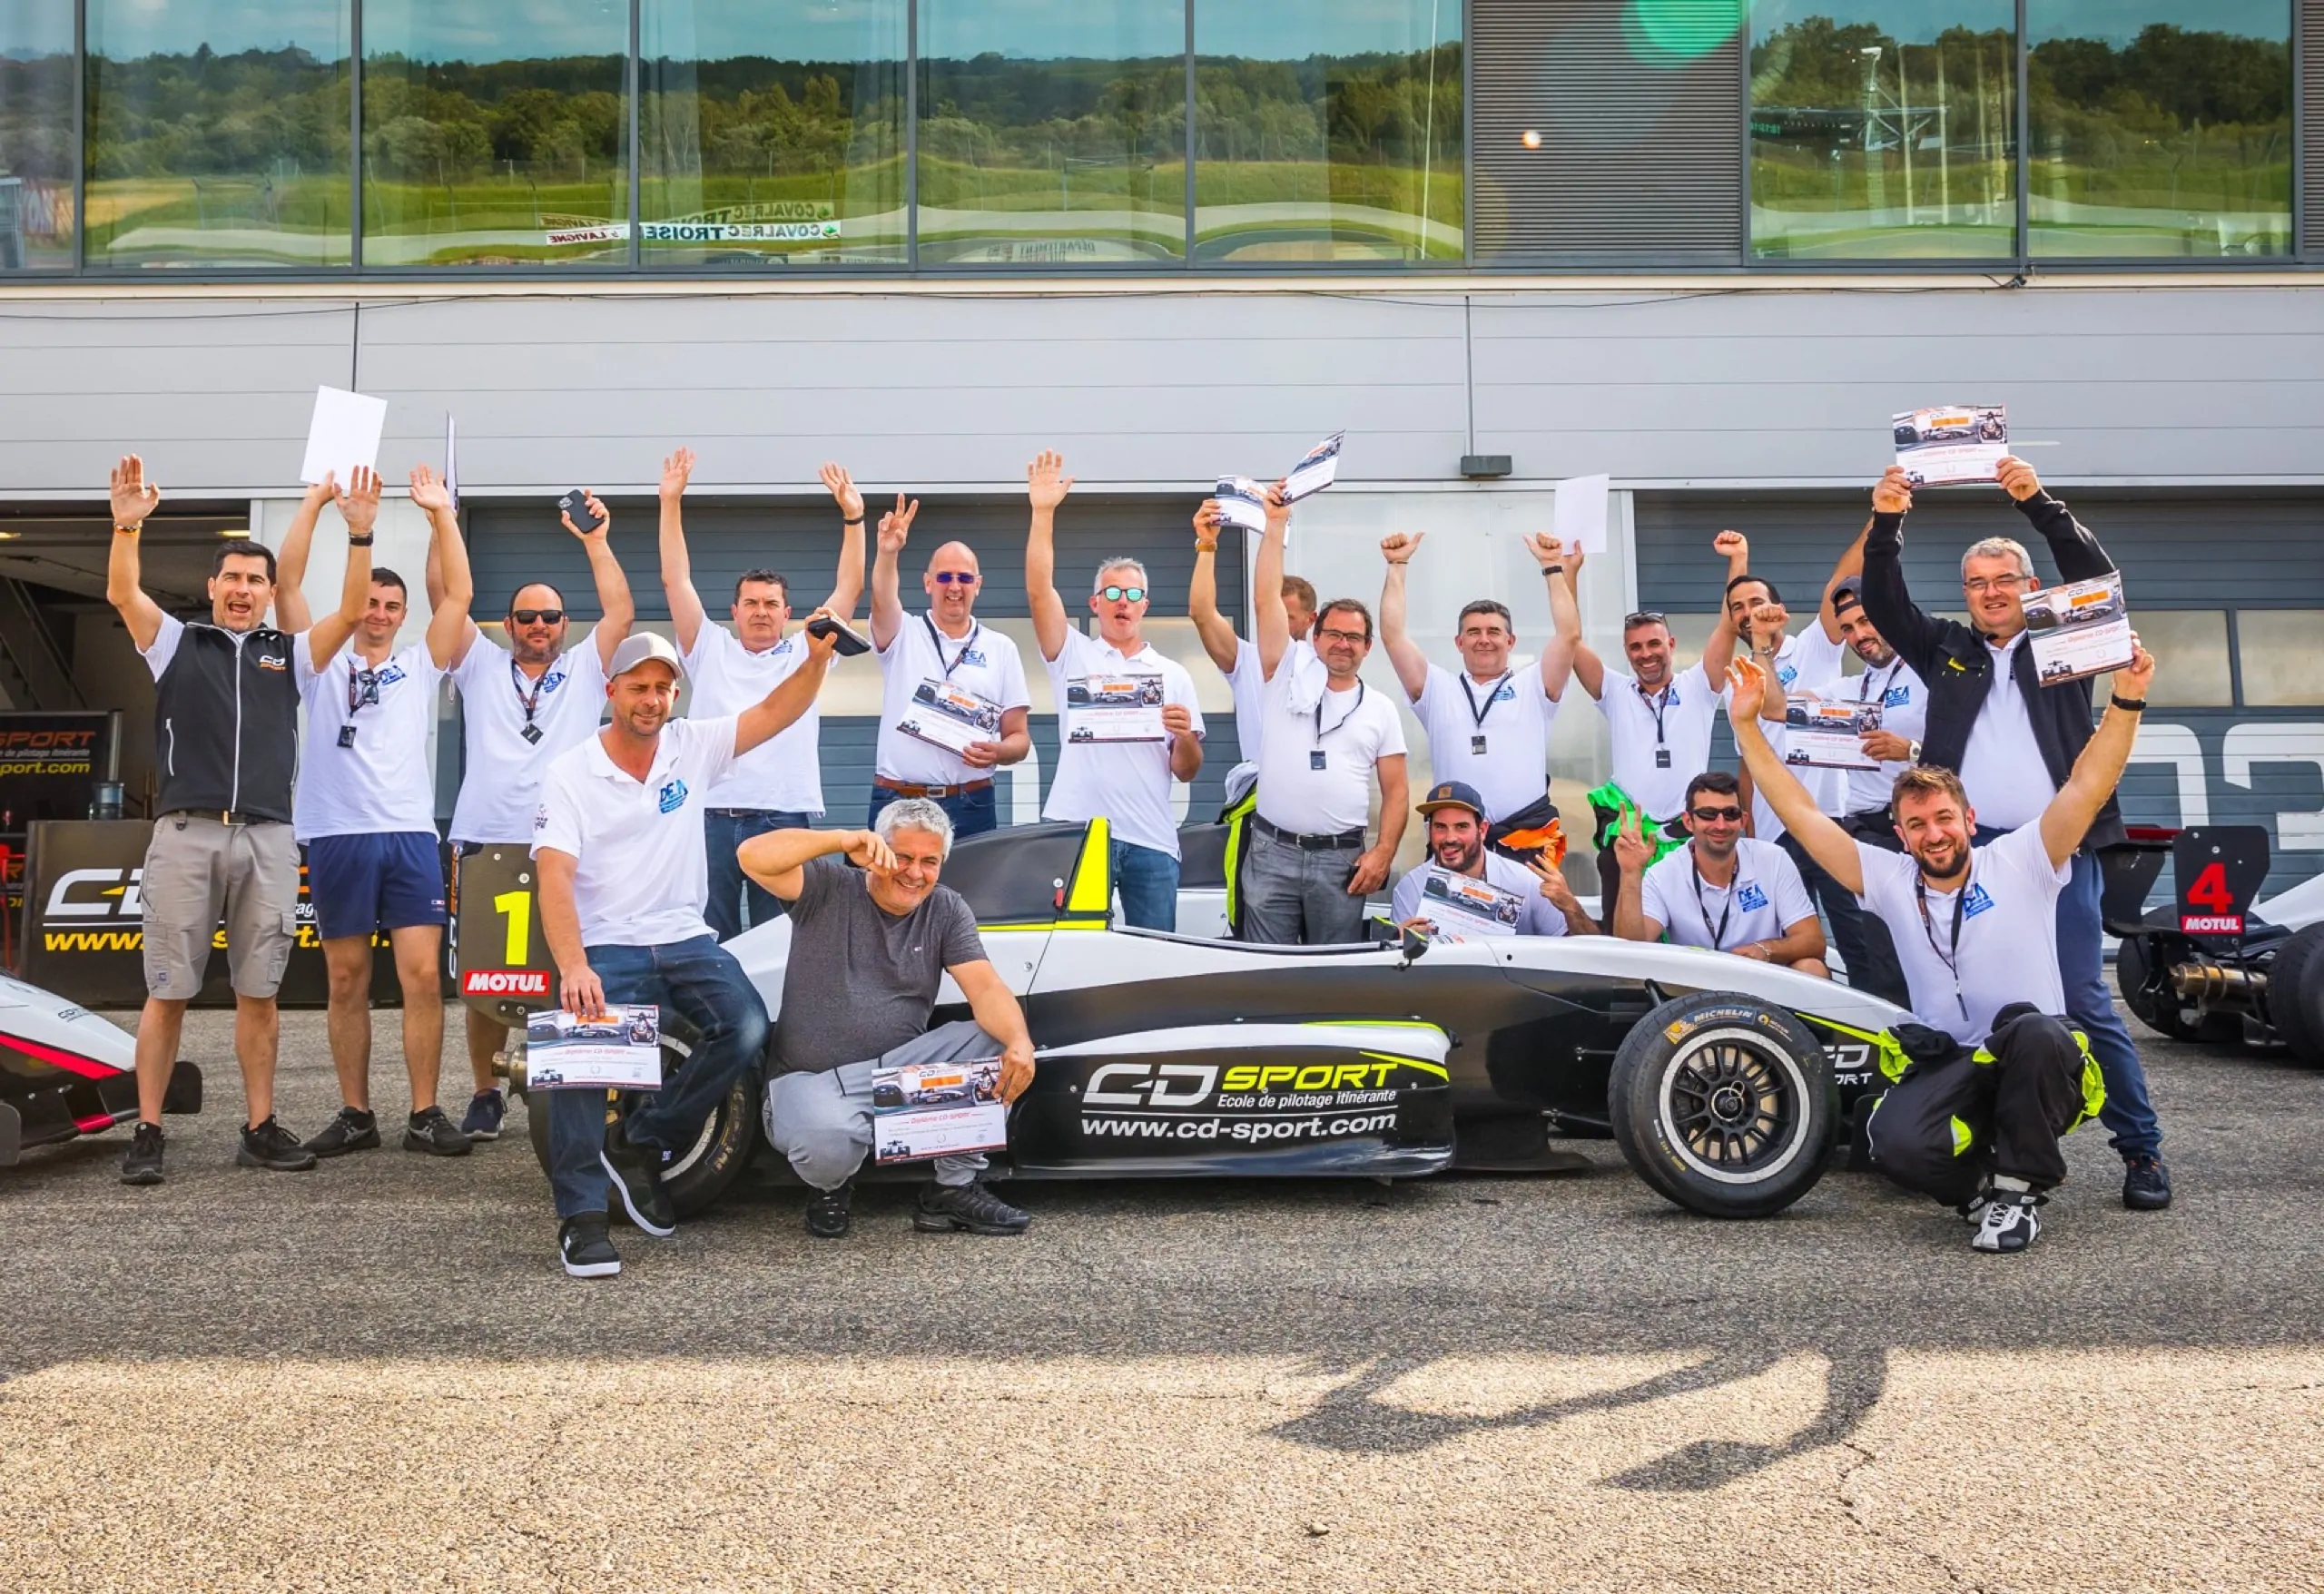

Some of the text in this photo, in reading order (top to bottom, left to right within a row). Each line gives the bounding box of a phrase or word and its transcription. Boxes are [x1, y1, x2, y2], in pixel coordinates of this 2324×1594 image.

[0, 732, 95, 747] PORT
[2186, 862, 2234, 914] 4
[494, 890, 531, 966] 1
[2185, 918, 2240, 930] MOTUL
[467, 973, 547, 992] MOTUL
[1694, 1009, 1753, 1022] MICHELIN
[1082, 1063, 1398, 1106] CD SPORT
[1217, 1089, 1396, 1109] Ecole de pilotage itinérante
[1081, 1113, 1397, 1144] www.cd-sport.com
